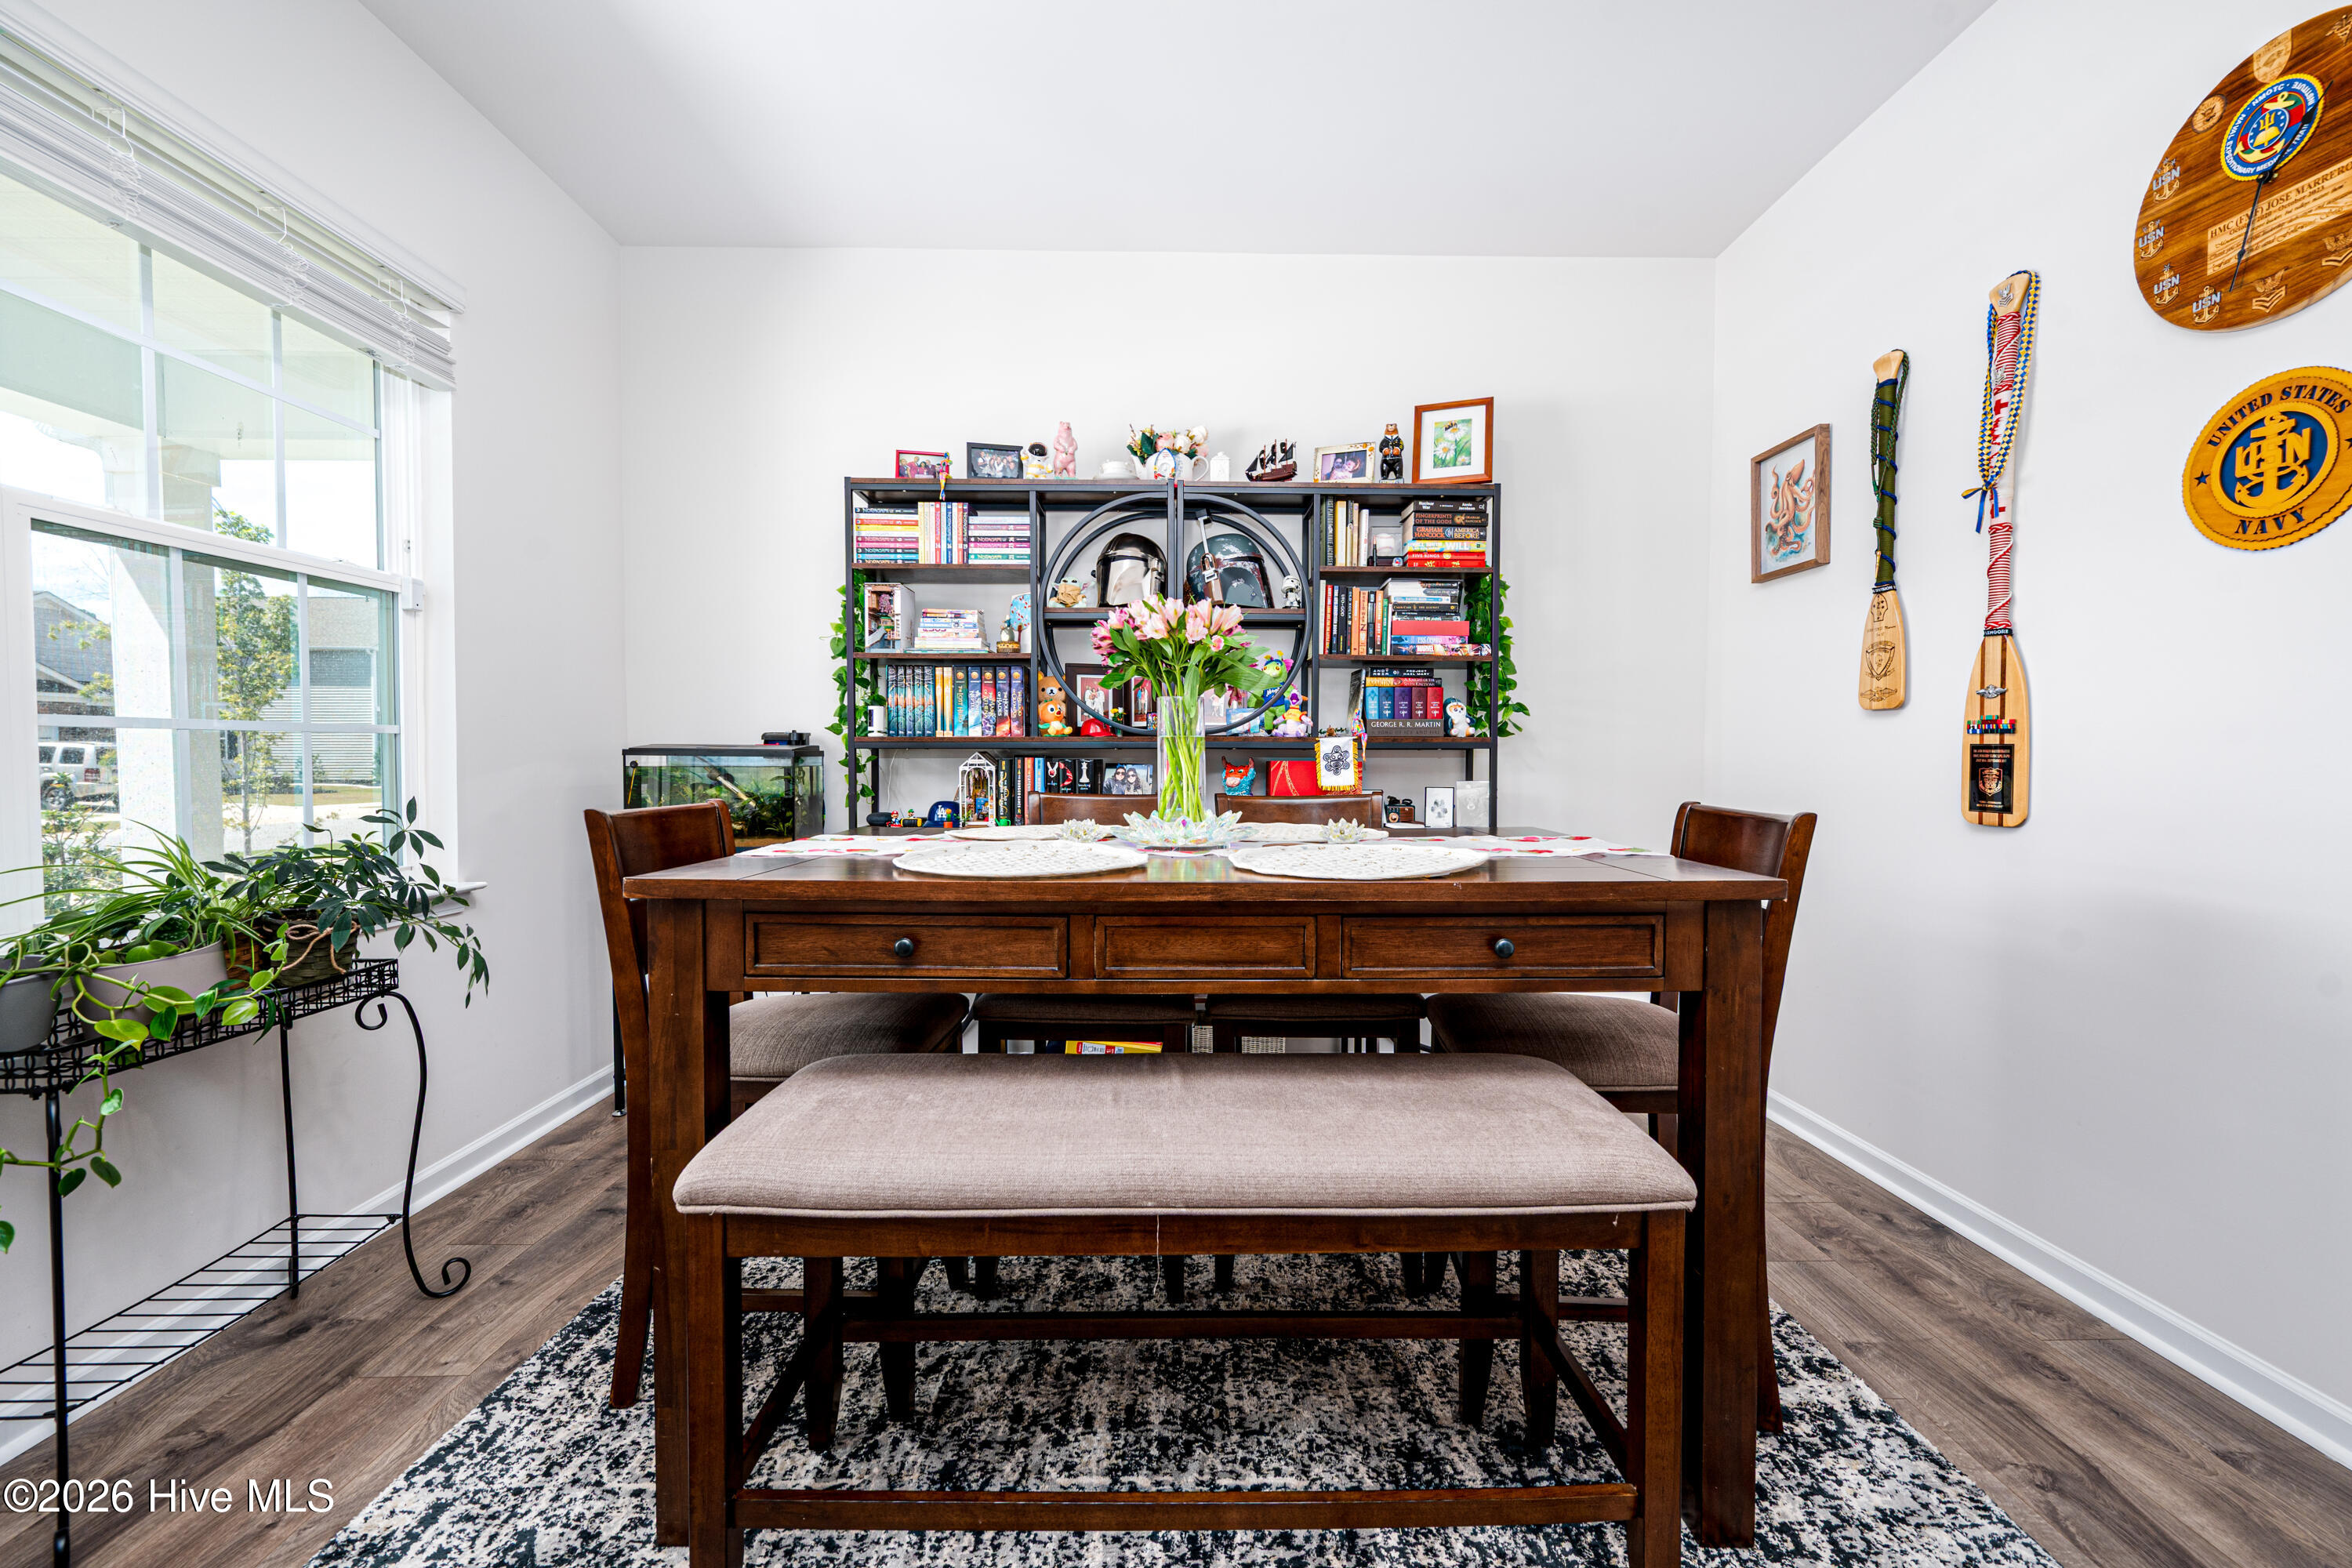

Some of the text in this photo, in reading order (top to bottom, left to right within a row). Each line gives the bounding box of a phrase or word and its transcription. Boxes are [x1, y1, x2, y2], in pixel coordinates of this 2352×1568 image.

[2252, 83, 2285, 106] NMOTC
[2228, 114, 2246, 140] NAVAL
[2153, 166, 2180, 191] USN
[2210, 220, 2234, 238] HMC
[2266, 193, 2292, 212] JOSE
[2295, 162, 2352, 196] MARRERO
[2139, 226, 2164, 248] USN
[2154, 274, 2180, 295] USN
[2192, 291, 2221, 314] USN
[2207, 384, 2352, 448] UNITED STATES
[2234, 506, 2305, 535] NAVY
[1445, 542, 1470, 550] WILL
